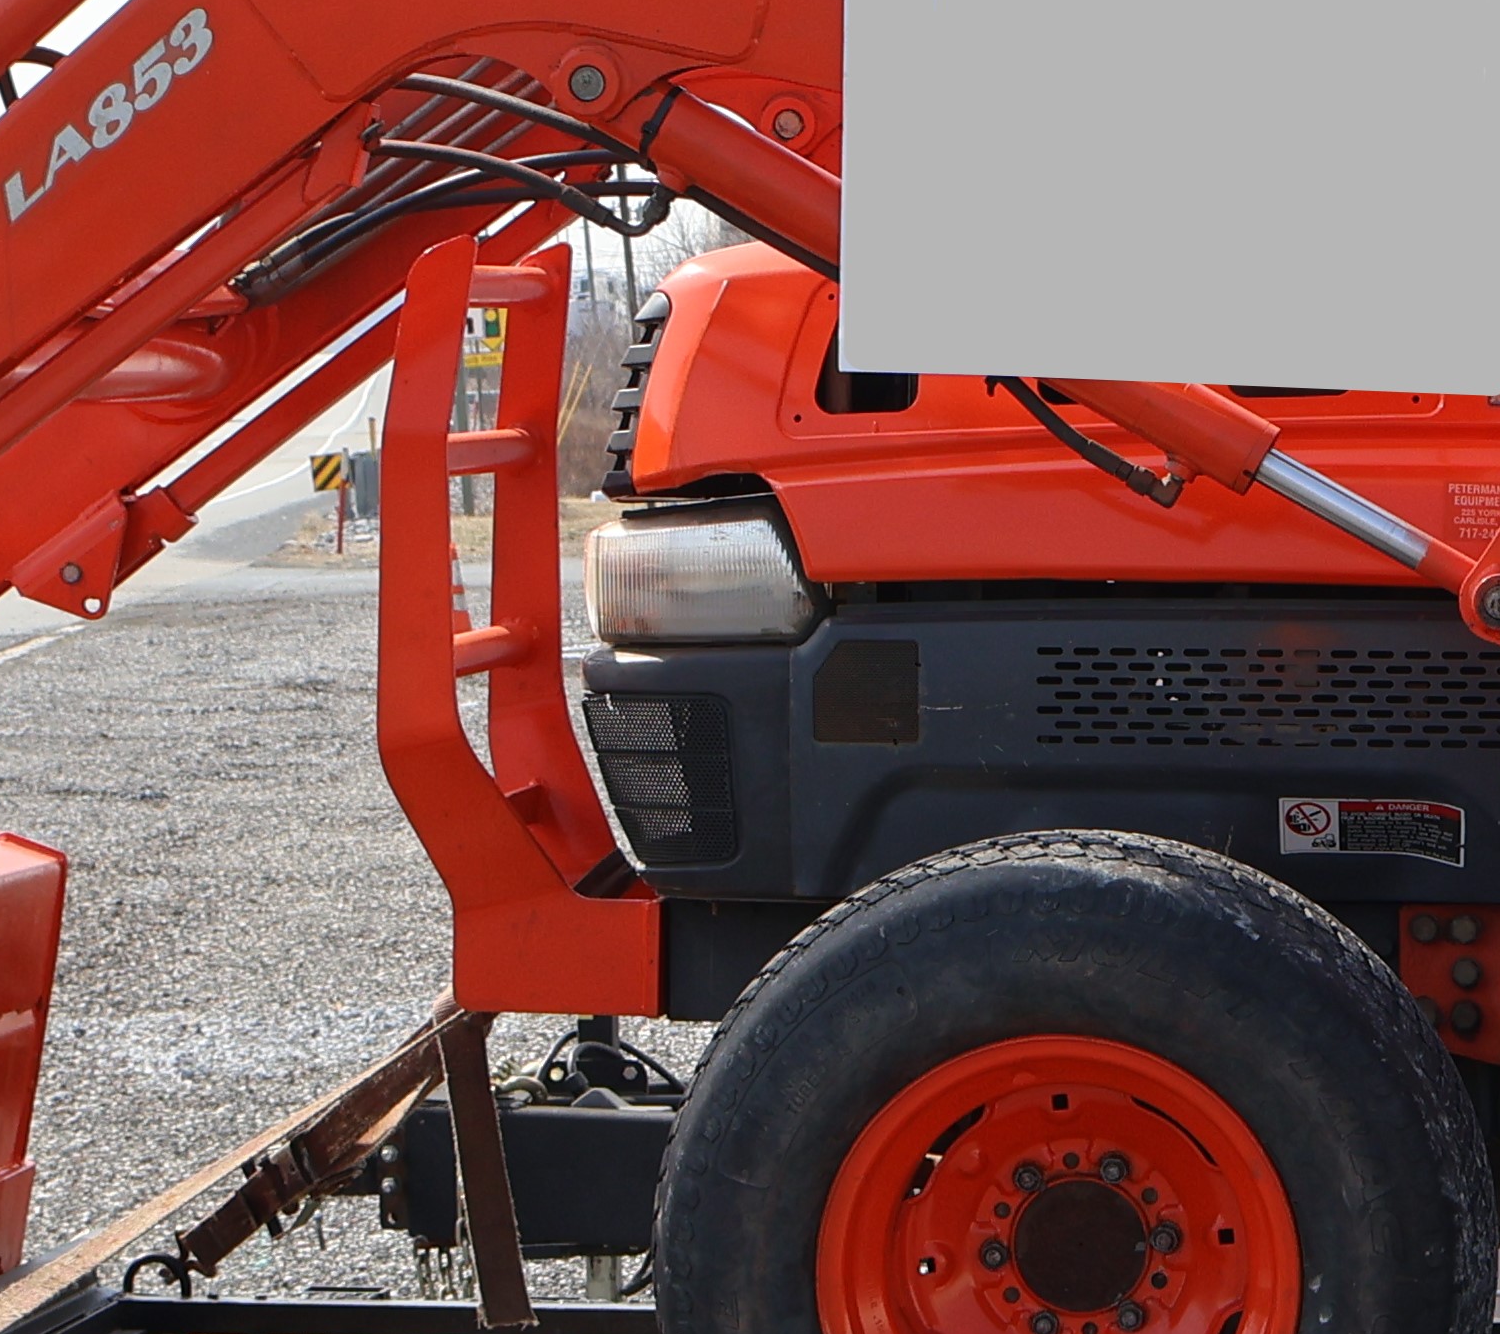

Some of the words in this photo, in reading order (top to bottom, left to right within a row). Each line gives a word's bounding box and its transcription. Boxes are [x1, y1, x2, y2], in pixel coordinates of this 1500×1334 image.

[4, 7, 213, 223] LA853
[1459, 527, 1498, 539] 717-24
[1388, 803, 1430, 812] DANGER
